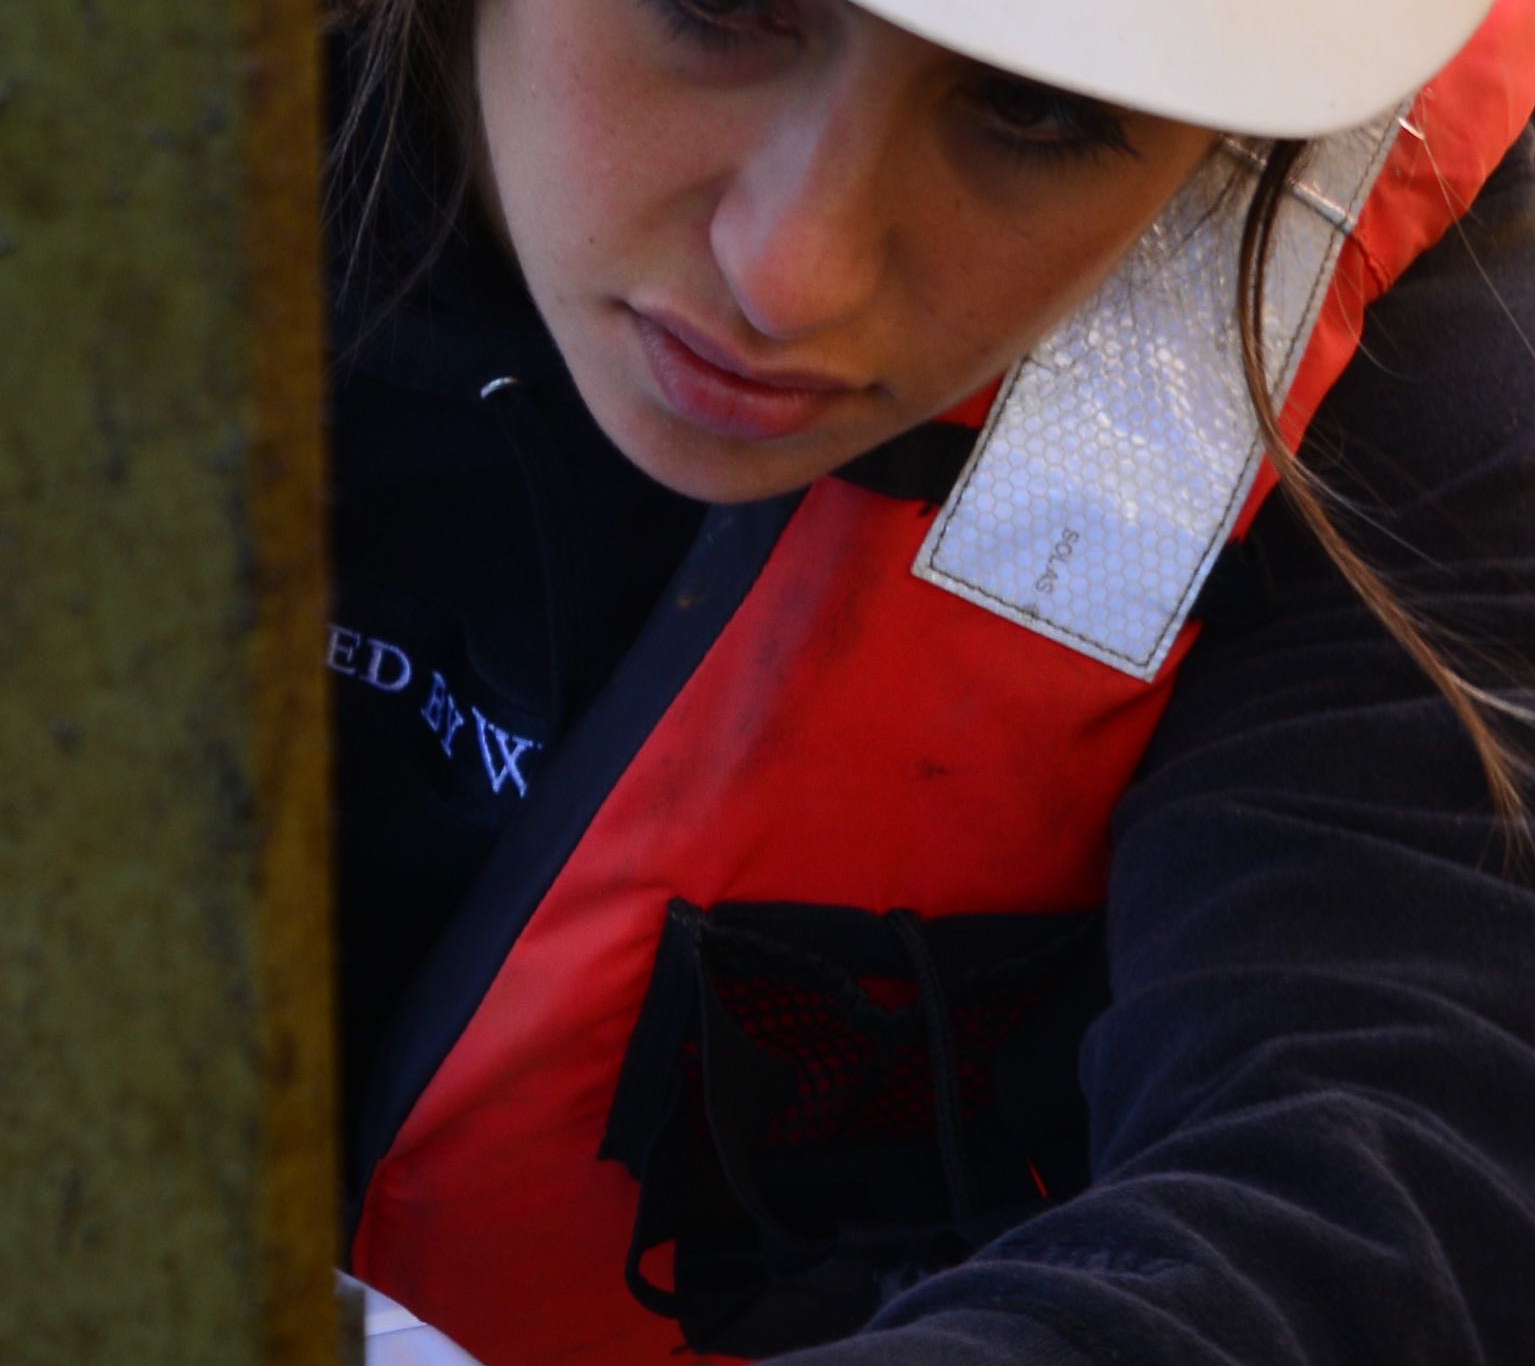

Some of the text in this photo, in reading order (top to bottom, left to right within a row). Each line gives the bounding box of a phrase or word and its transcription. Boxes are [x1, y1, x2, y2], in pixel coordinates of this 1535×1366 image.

[1036, 528, 1079, 594] SOLAS
[326, 622, 413, 692] ED
[471, 706, 543, 799] W
